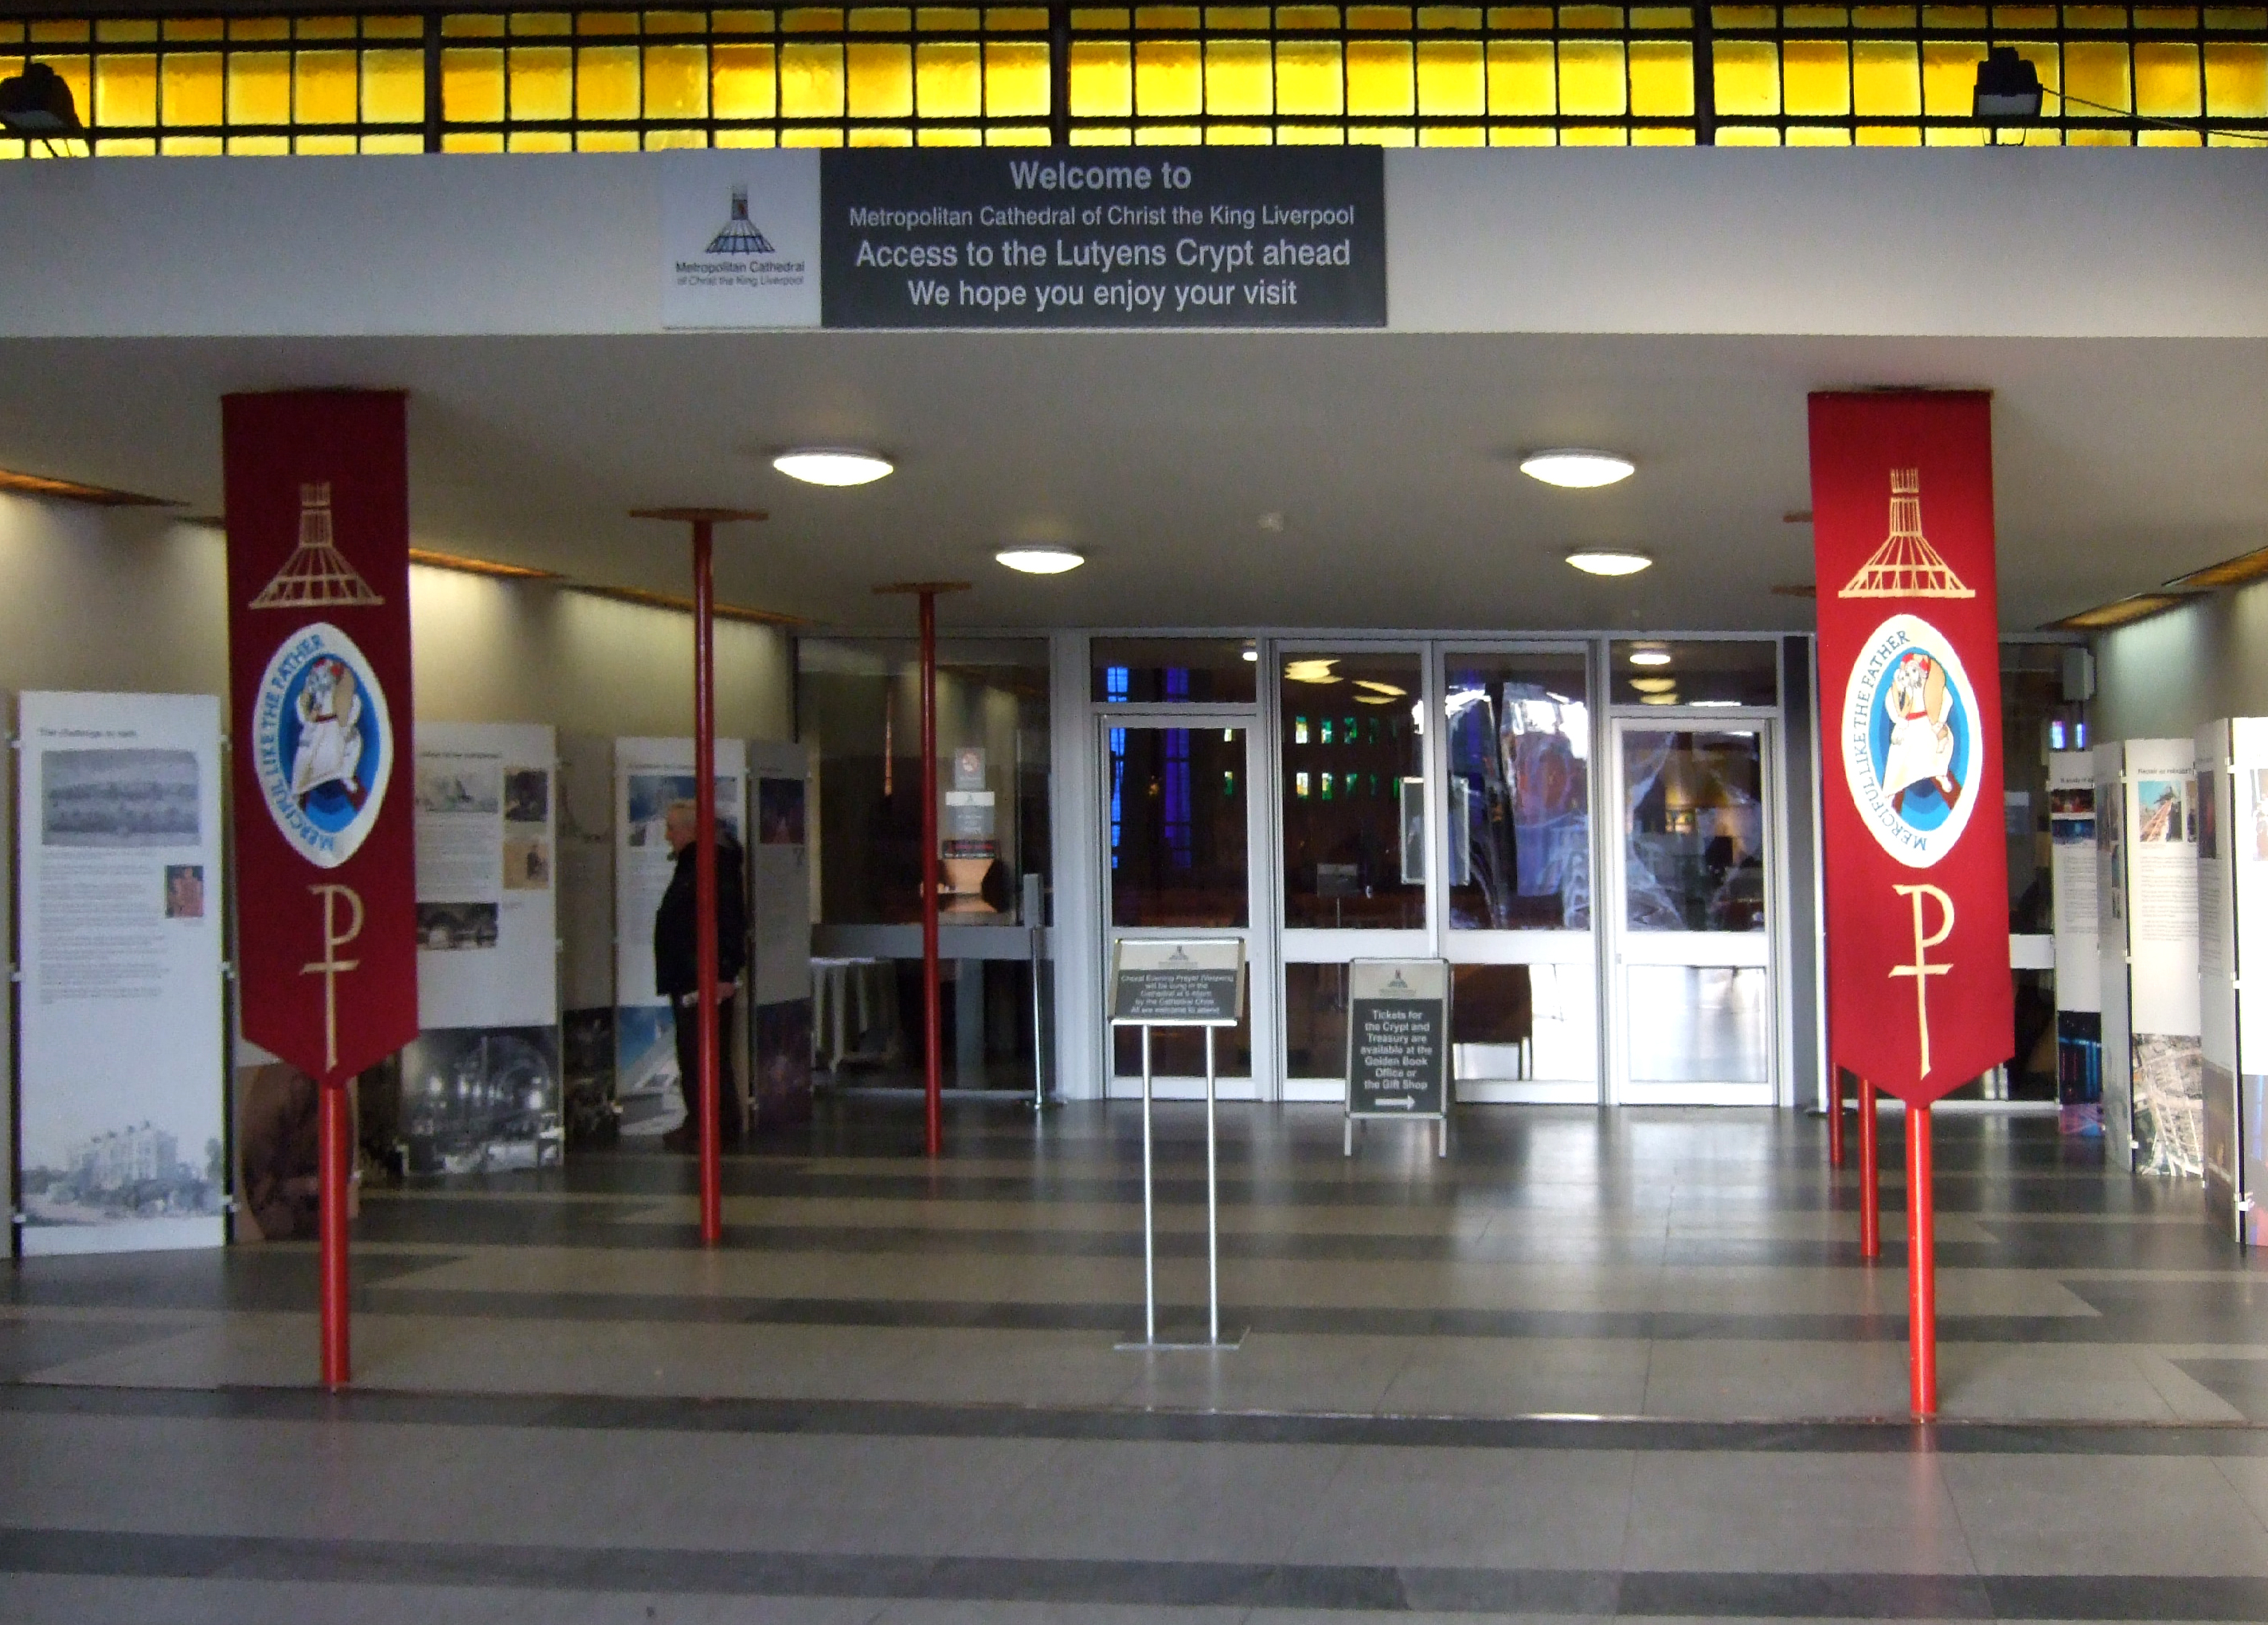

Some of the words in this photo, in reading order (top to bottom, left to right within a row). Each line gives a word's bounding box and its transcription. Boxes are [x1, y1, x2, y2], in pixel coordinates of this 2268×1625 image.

[1009, 160, 1152, 190] Welcome
[1161, 162, 1191, 190] to
[850, 206, 972, 231] Metropolitan
[980, 206, 1075, 225] Cathedral
[1082, 206, 1102, 225] of
[1108, 205, 1166, 225] Christ
[1171, 206, 1203, 225] the
[1210, 205, 1255, 229] King
[1262, 204, 1354, 229] Liverpool
[675, 261, 746, 275] Metropolitan
[749, 260, 805, 273] Cathedral
[856, 239, 958, 267] Access
[966, 241, 993, 266] to
[1002, 240, 1046, 266] the
[1057, 239, 1167, 272] Lutyens
[1175, 238, 1254, 272] Crypt
[1263, 239, 1350, 266] ahead
[908, 280, 951, 306] We
[959, 280, 1026, 311] hope
[1035, 284, 1084, 312] you
[1093, 279, 1166, 311] enjoy
[1175, 284, 1235, 311] your
[1243, 279, 1297, 305] visit
[272, 634, 323, 688] FATHER
[1861, 630, 1910, 688] FATHER
[260, 691, 279, 728] THE
[1853, 691, 1871, 728] THE
[260, 730, 279, 777] LIKE
[1853, 732, 1871, 776] LIKE
[271, 783, 334, 852] MERCIFUL
[1861, 777, 1927, 851] MERCIFUL
[1364, 1022, 1381, 1032] the
[1382, 1021, 1409, 1033] Crypt
[1410, 1022, 1430, 1032] and
[1372, 1010, 1406, 1020] Tickets
[1408, 1010, 1423, 1020] for
[1360, 1045, 1403, 1055] available
[1406, 1046, 1414, 1055] at
[1417, 1045, 1433, 1055] the
[1367, 1033, 1409, 1044] Treasury
[1364, 1055, 1400, 1066] Golden
[1402, 1055, 1428, 1066] Book
[1374, 1067, 1404, 1078] Office
[1364, 1079, 1380, 1090] the
[1382, 1079, 1400, 1090] Gift
[1402, 1079, 1428, 1091] Shop
